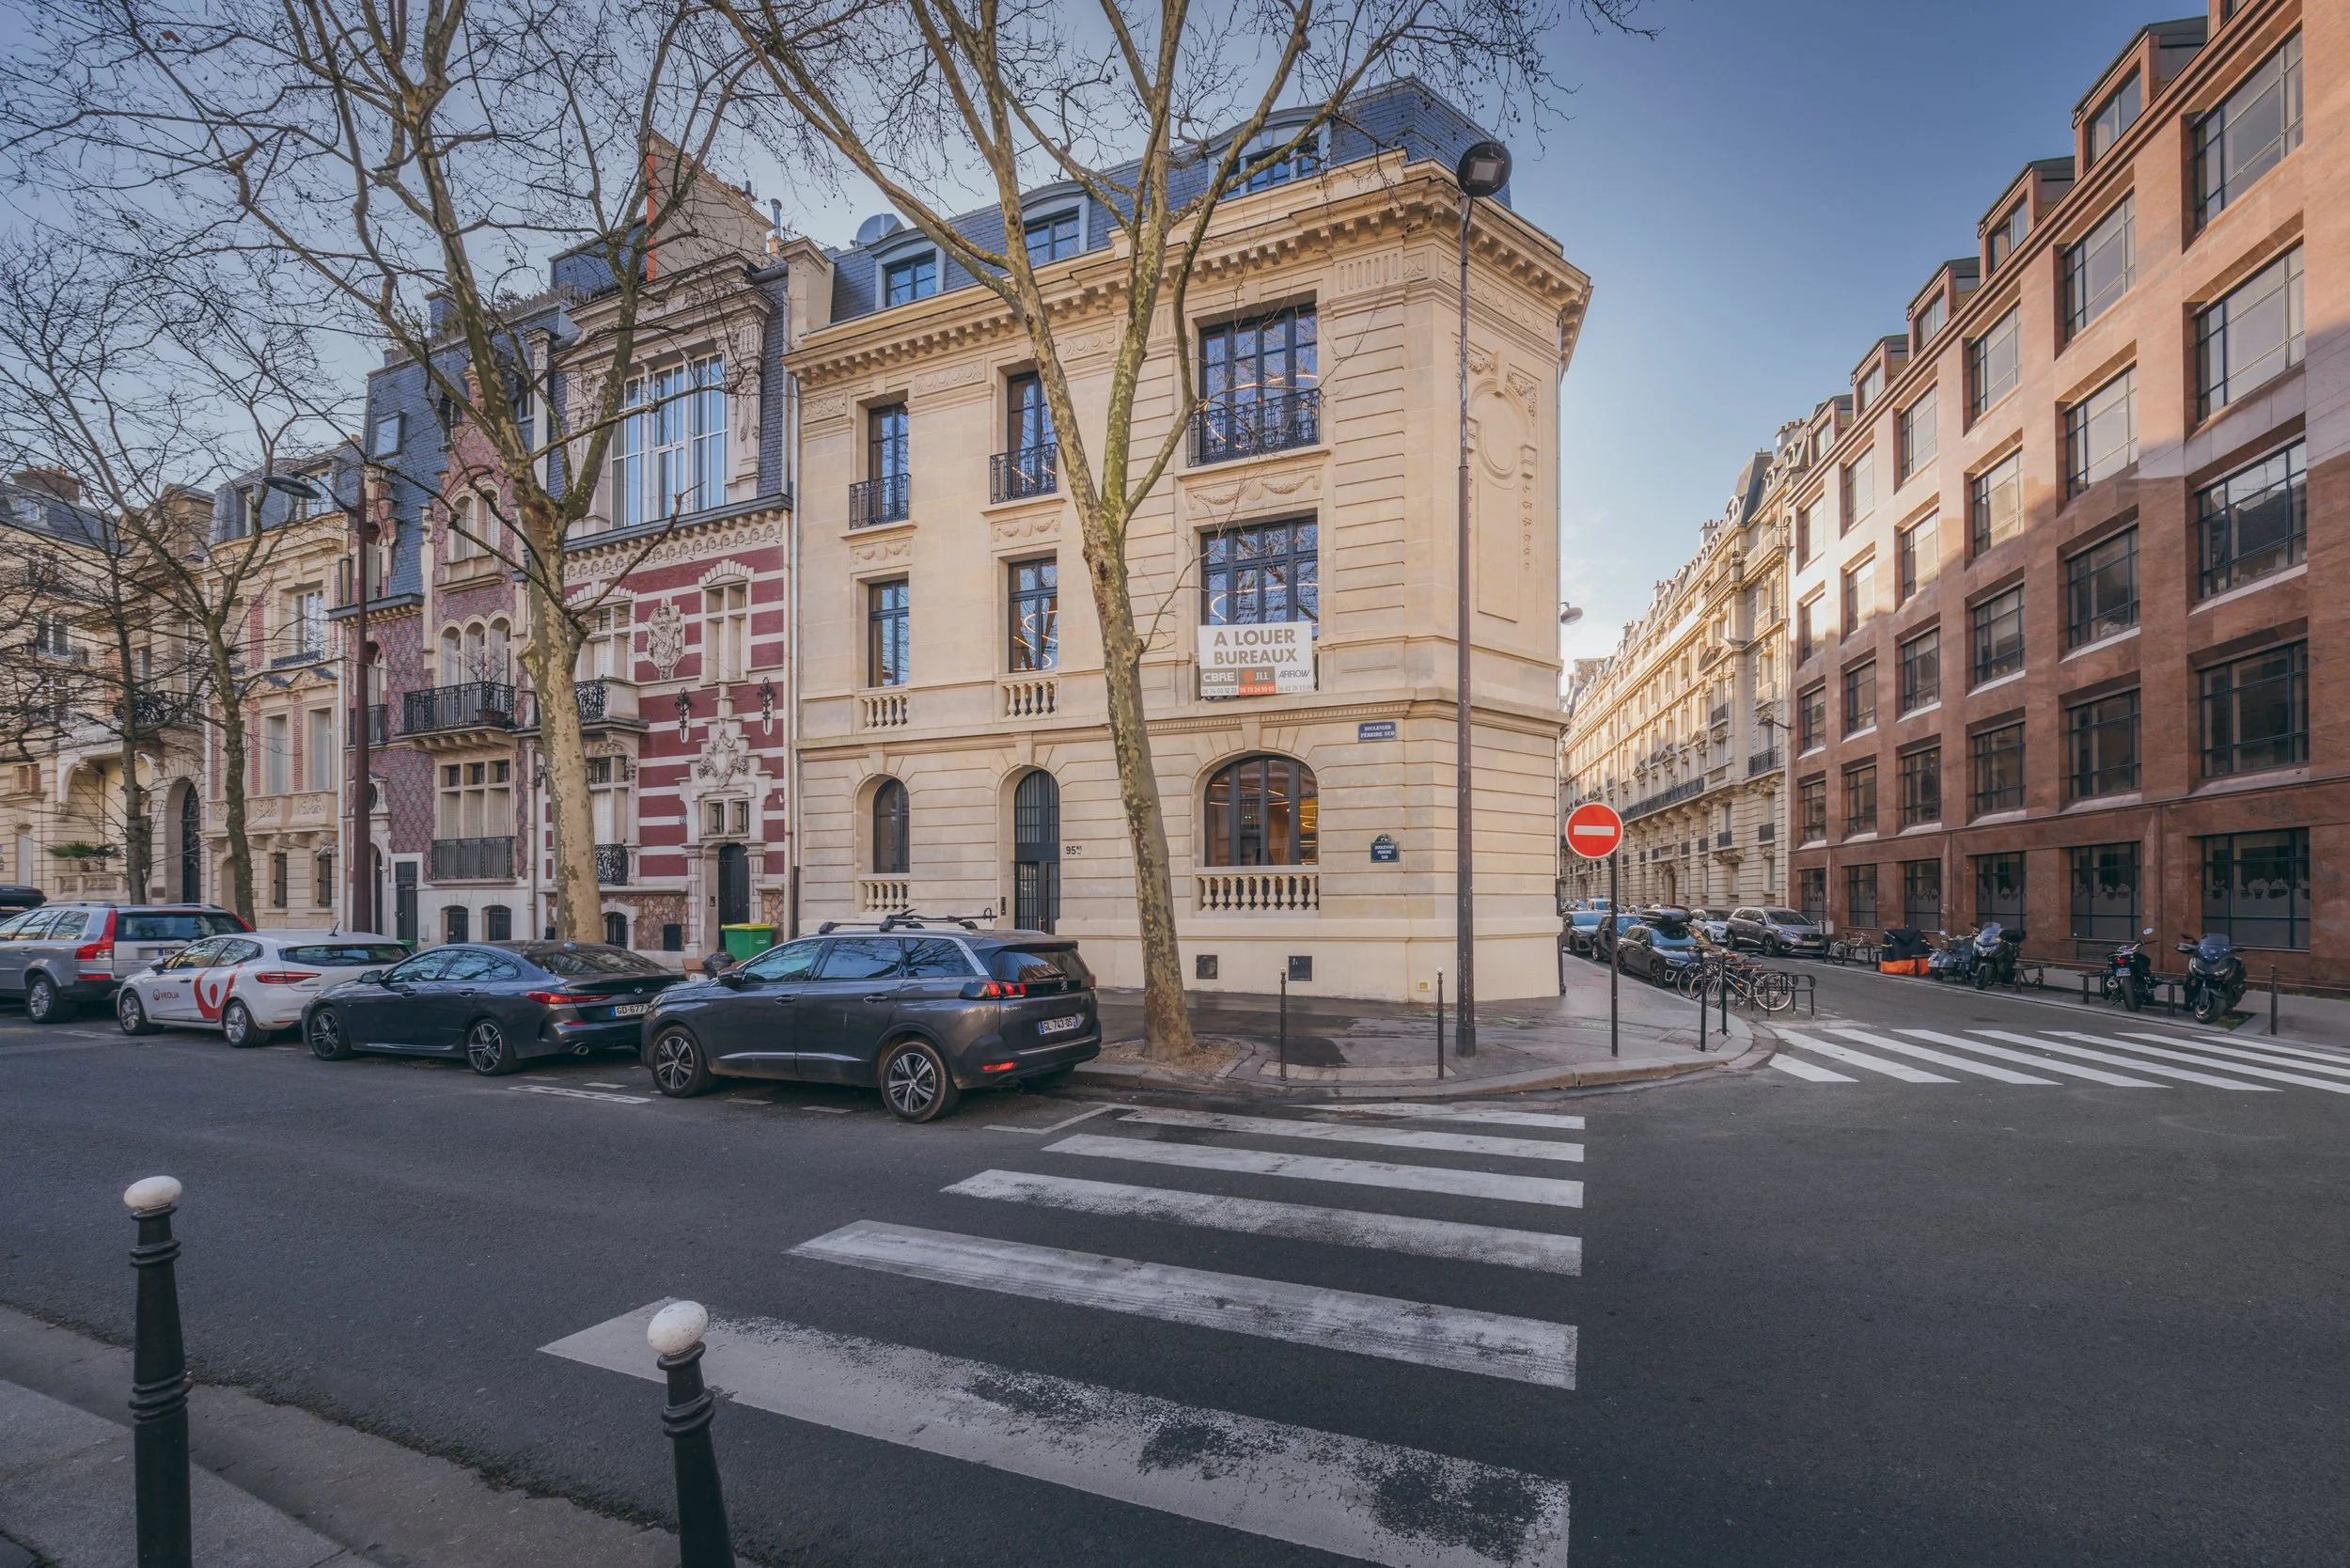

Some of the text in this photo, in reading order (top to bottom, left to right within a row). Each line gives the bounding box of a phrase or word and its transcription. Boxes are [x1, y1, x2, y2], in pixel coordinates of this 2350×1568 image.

[1214, 628, 1296, 647] A LOUER
[1214, 648, 1298, 666] BUREAUX
[1202, 671, 1235, 682] CBRE
[1255, 671, 1271, 682] JLL
[1278, 668, 1311, 679] ARROW
[160, 991, 180, 999] VEOLIA
